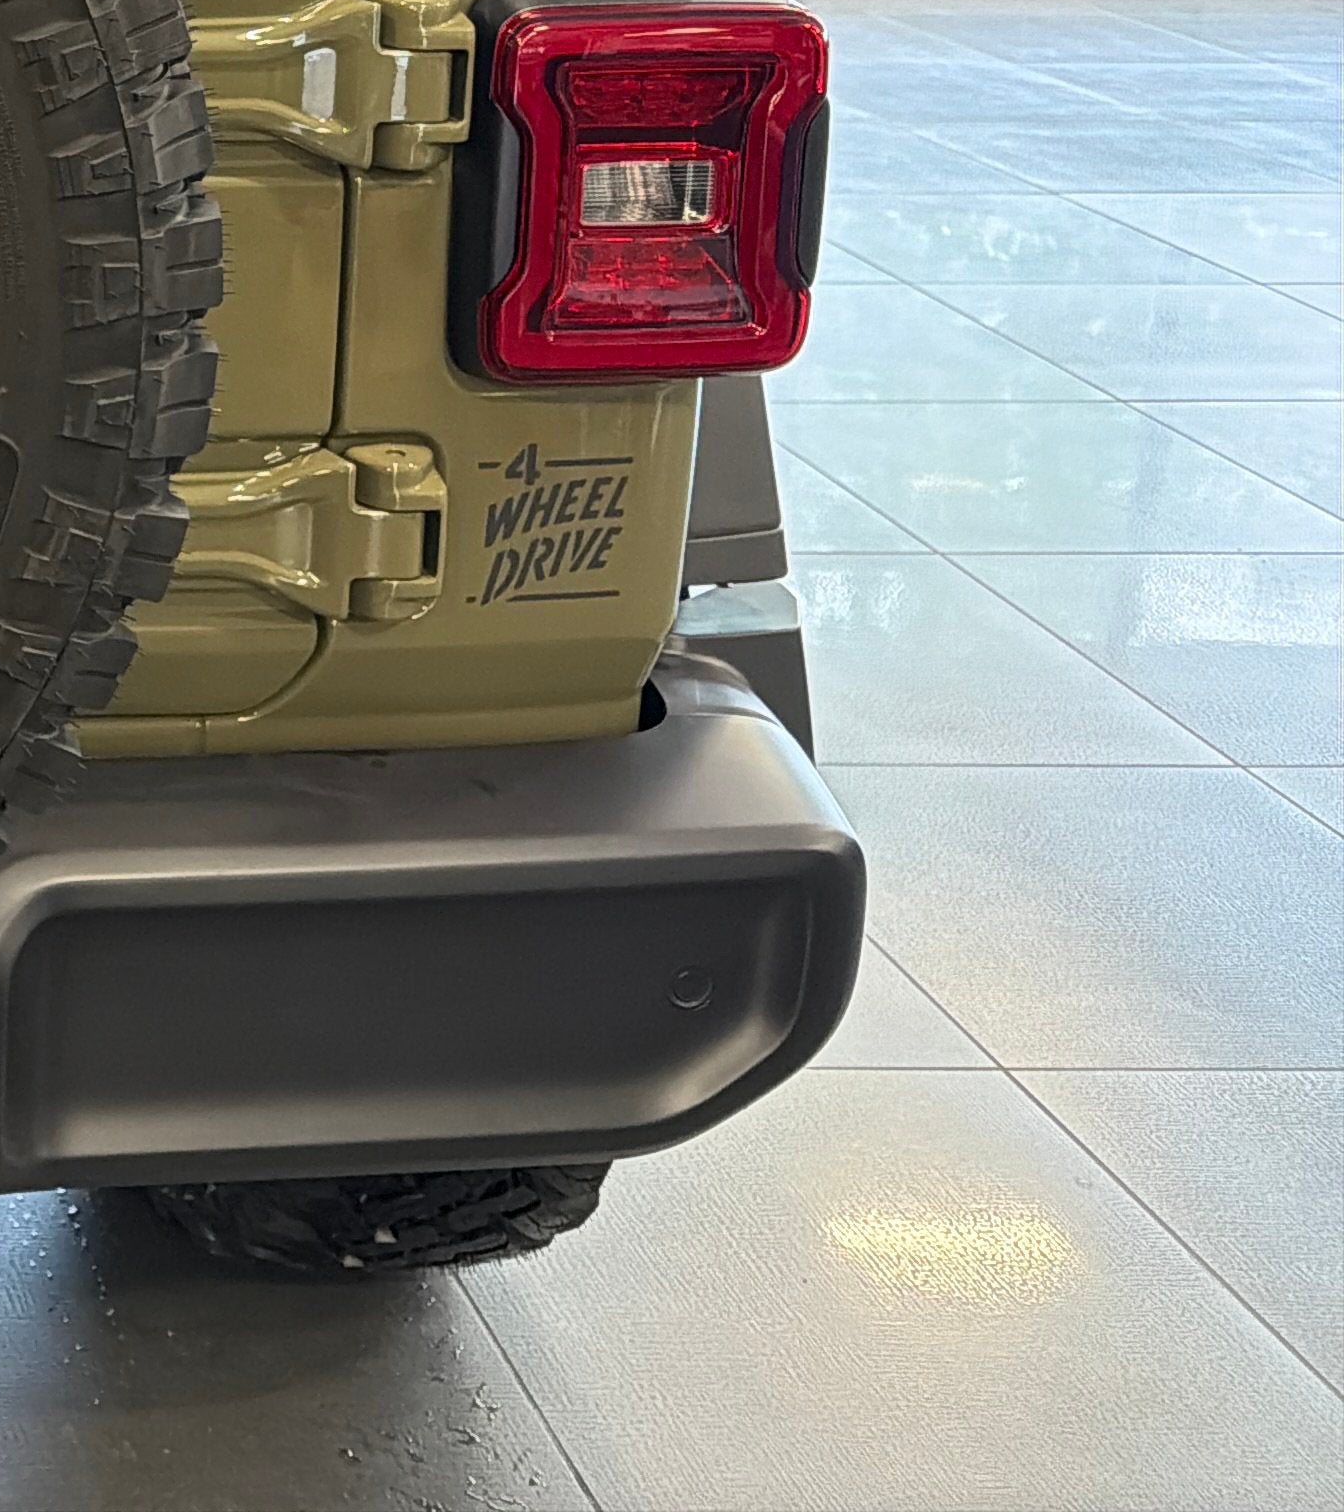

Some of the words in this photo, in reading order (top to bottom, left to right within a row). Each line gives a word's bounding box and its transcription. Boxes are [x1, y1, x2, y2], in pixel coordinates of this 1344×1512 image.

[505, 443, 541, 486] 4
[484, 476, 628, 548] WHEEL
[480, 527, 623, 606] DRIVE
